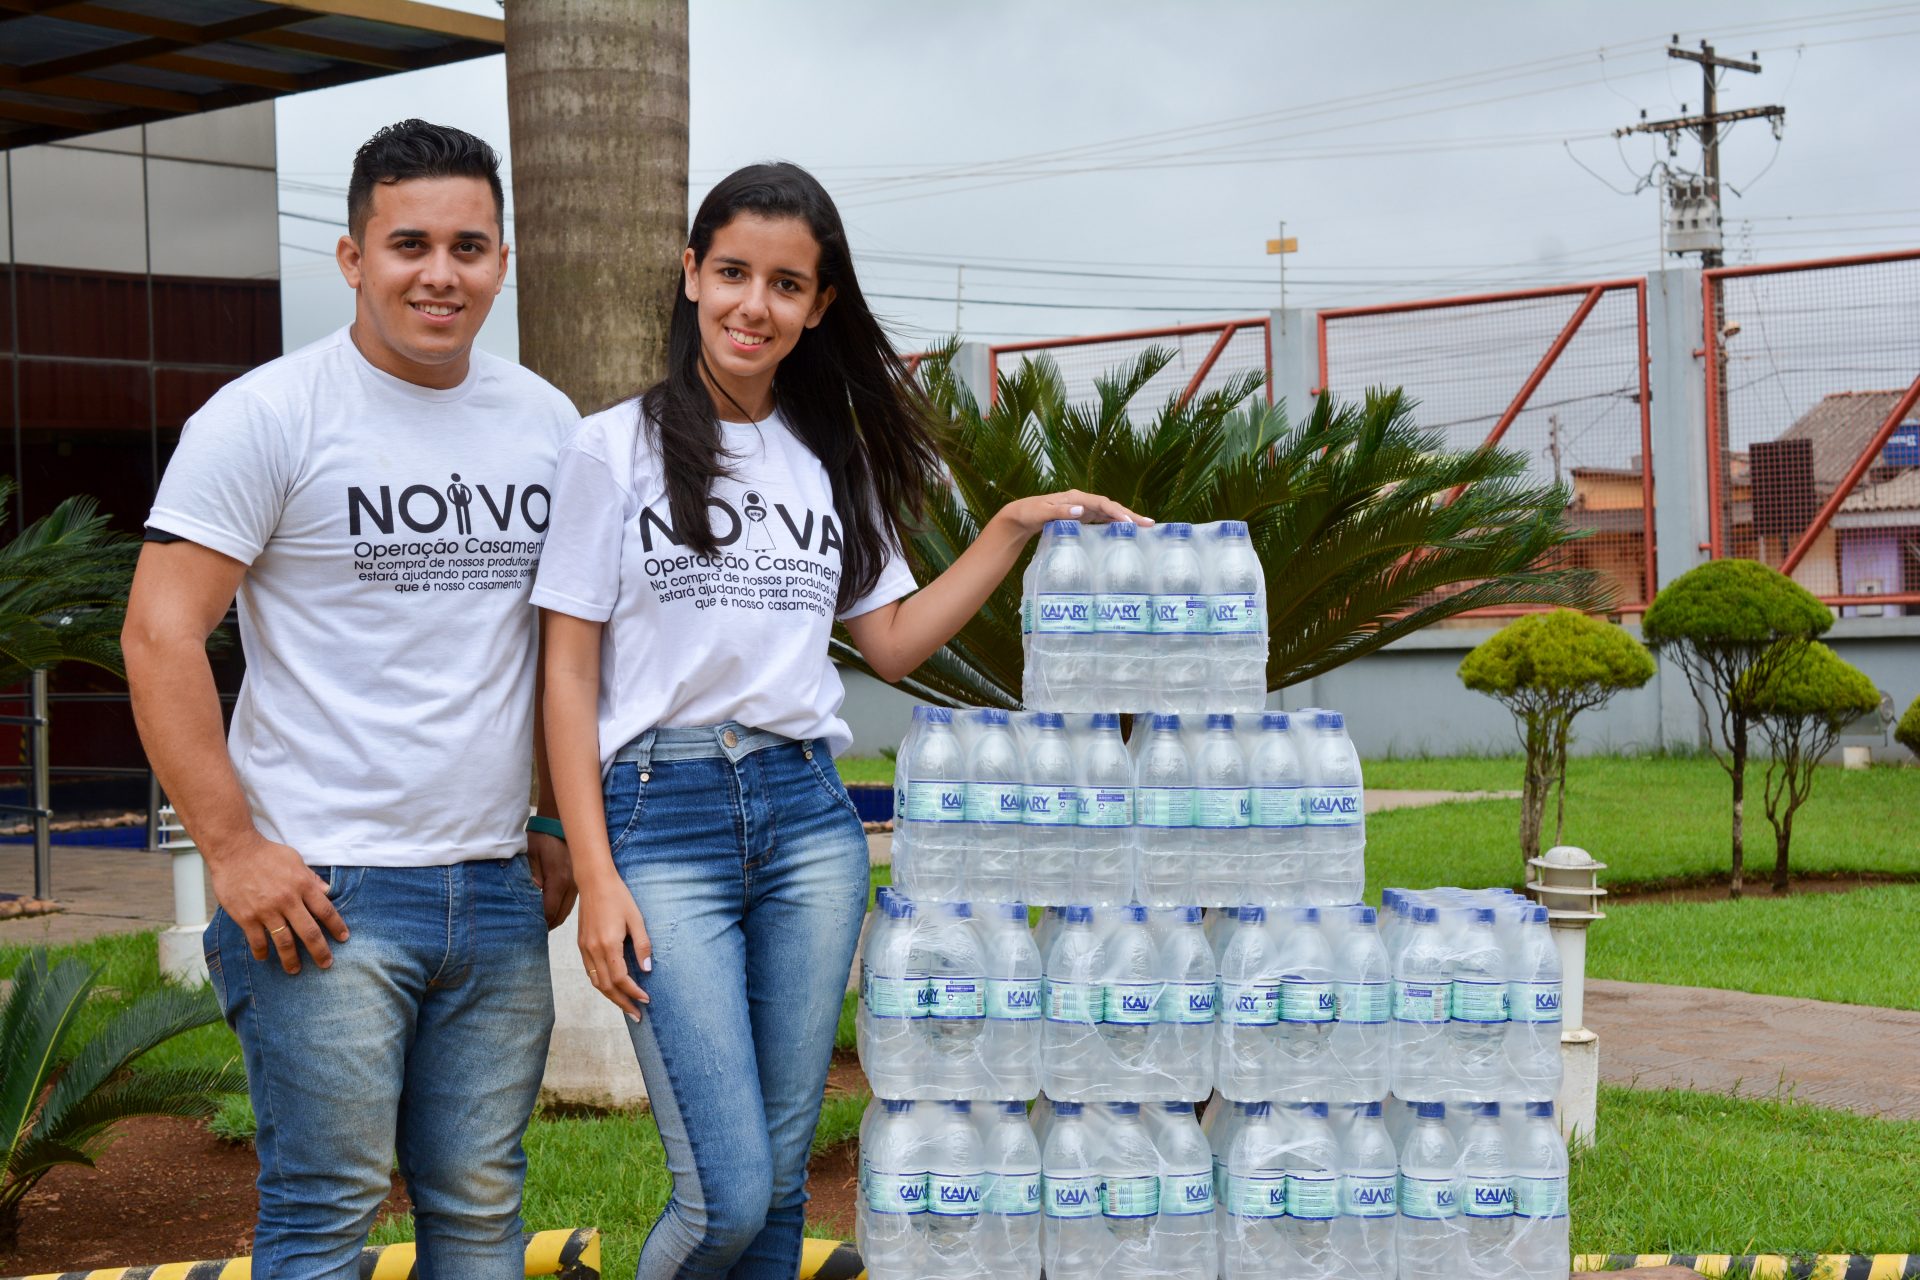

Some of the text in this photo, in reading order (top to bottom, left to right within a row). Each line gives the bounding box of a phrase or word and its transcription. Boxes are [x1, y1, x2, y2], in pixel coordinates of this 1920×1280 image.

[354, 538, 545, 560] Operação Casament
[354, 561, 373, 570] Na
[378, 559, 427, 571] compra
[430, 558, 445, 568] de
[449, 558, 484, 567] nossos
[488, 556, 529, 569] produtos
[644, 552, 840, 586] Operação Casament
[359, 569, 398, 581] estará
[402, 568, 459, 582] ajudando
[462, 570, 487, 581] para
[492, 569, 518, 578] nosso
[650, 580, 667, 591] Na
[671, 572, 720, 587] compra
[723, 571, 740, 583] de
[743, 576, 782, 586] nossos
[786, 576, 829, 595] produtos
[395, 579, 522, 594] que é nosso casamento
[659, 585, 695, 603] estará
[698, 583, 756, 597] ajudando
[759, 588, 788, 600] para
[792, 589, 821, 602] nosso
[695, 594, 826, 617] que é nosso casamento
[1475, 1187, 1513, 1204] KAIAR
